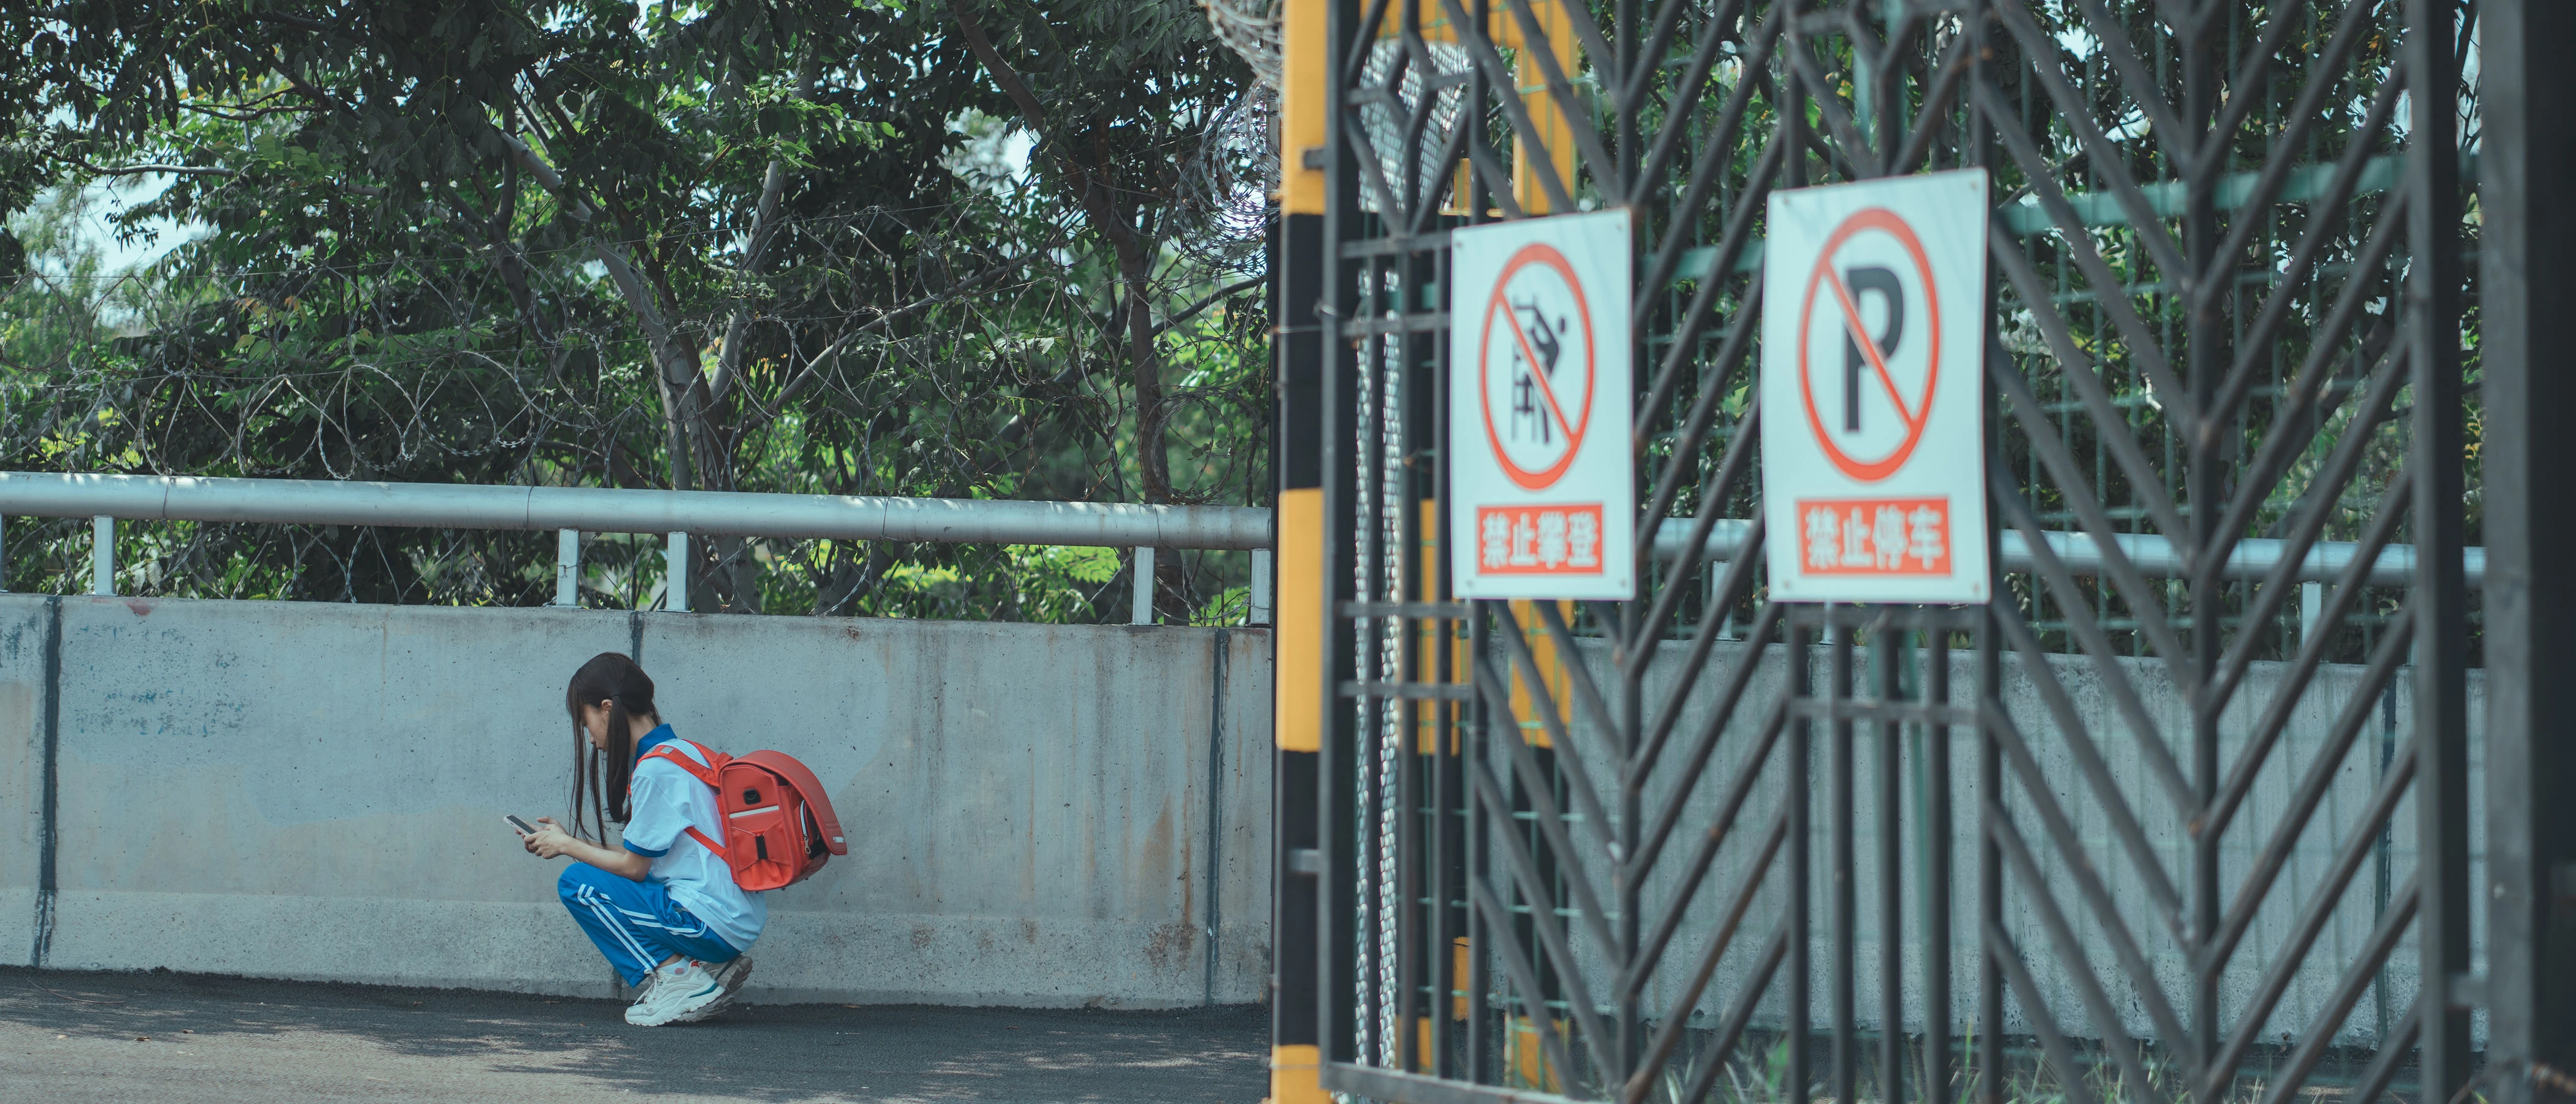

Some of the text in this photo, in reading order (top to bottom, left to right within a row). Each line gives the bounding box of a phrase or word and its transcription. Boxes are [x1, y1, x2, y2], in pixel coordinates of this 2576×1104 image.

[1847, 266, 1904, 432] P
[1483, 512, 1598, 569] 禁止攀登
[1805, 505, 1945, 570] 禁止停车
